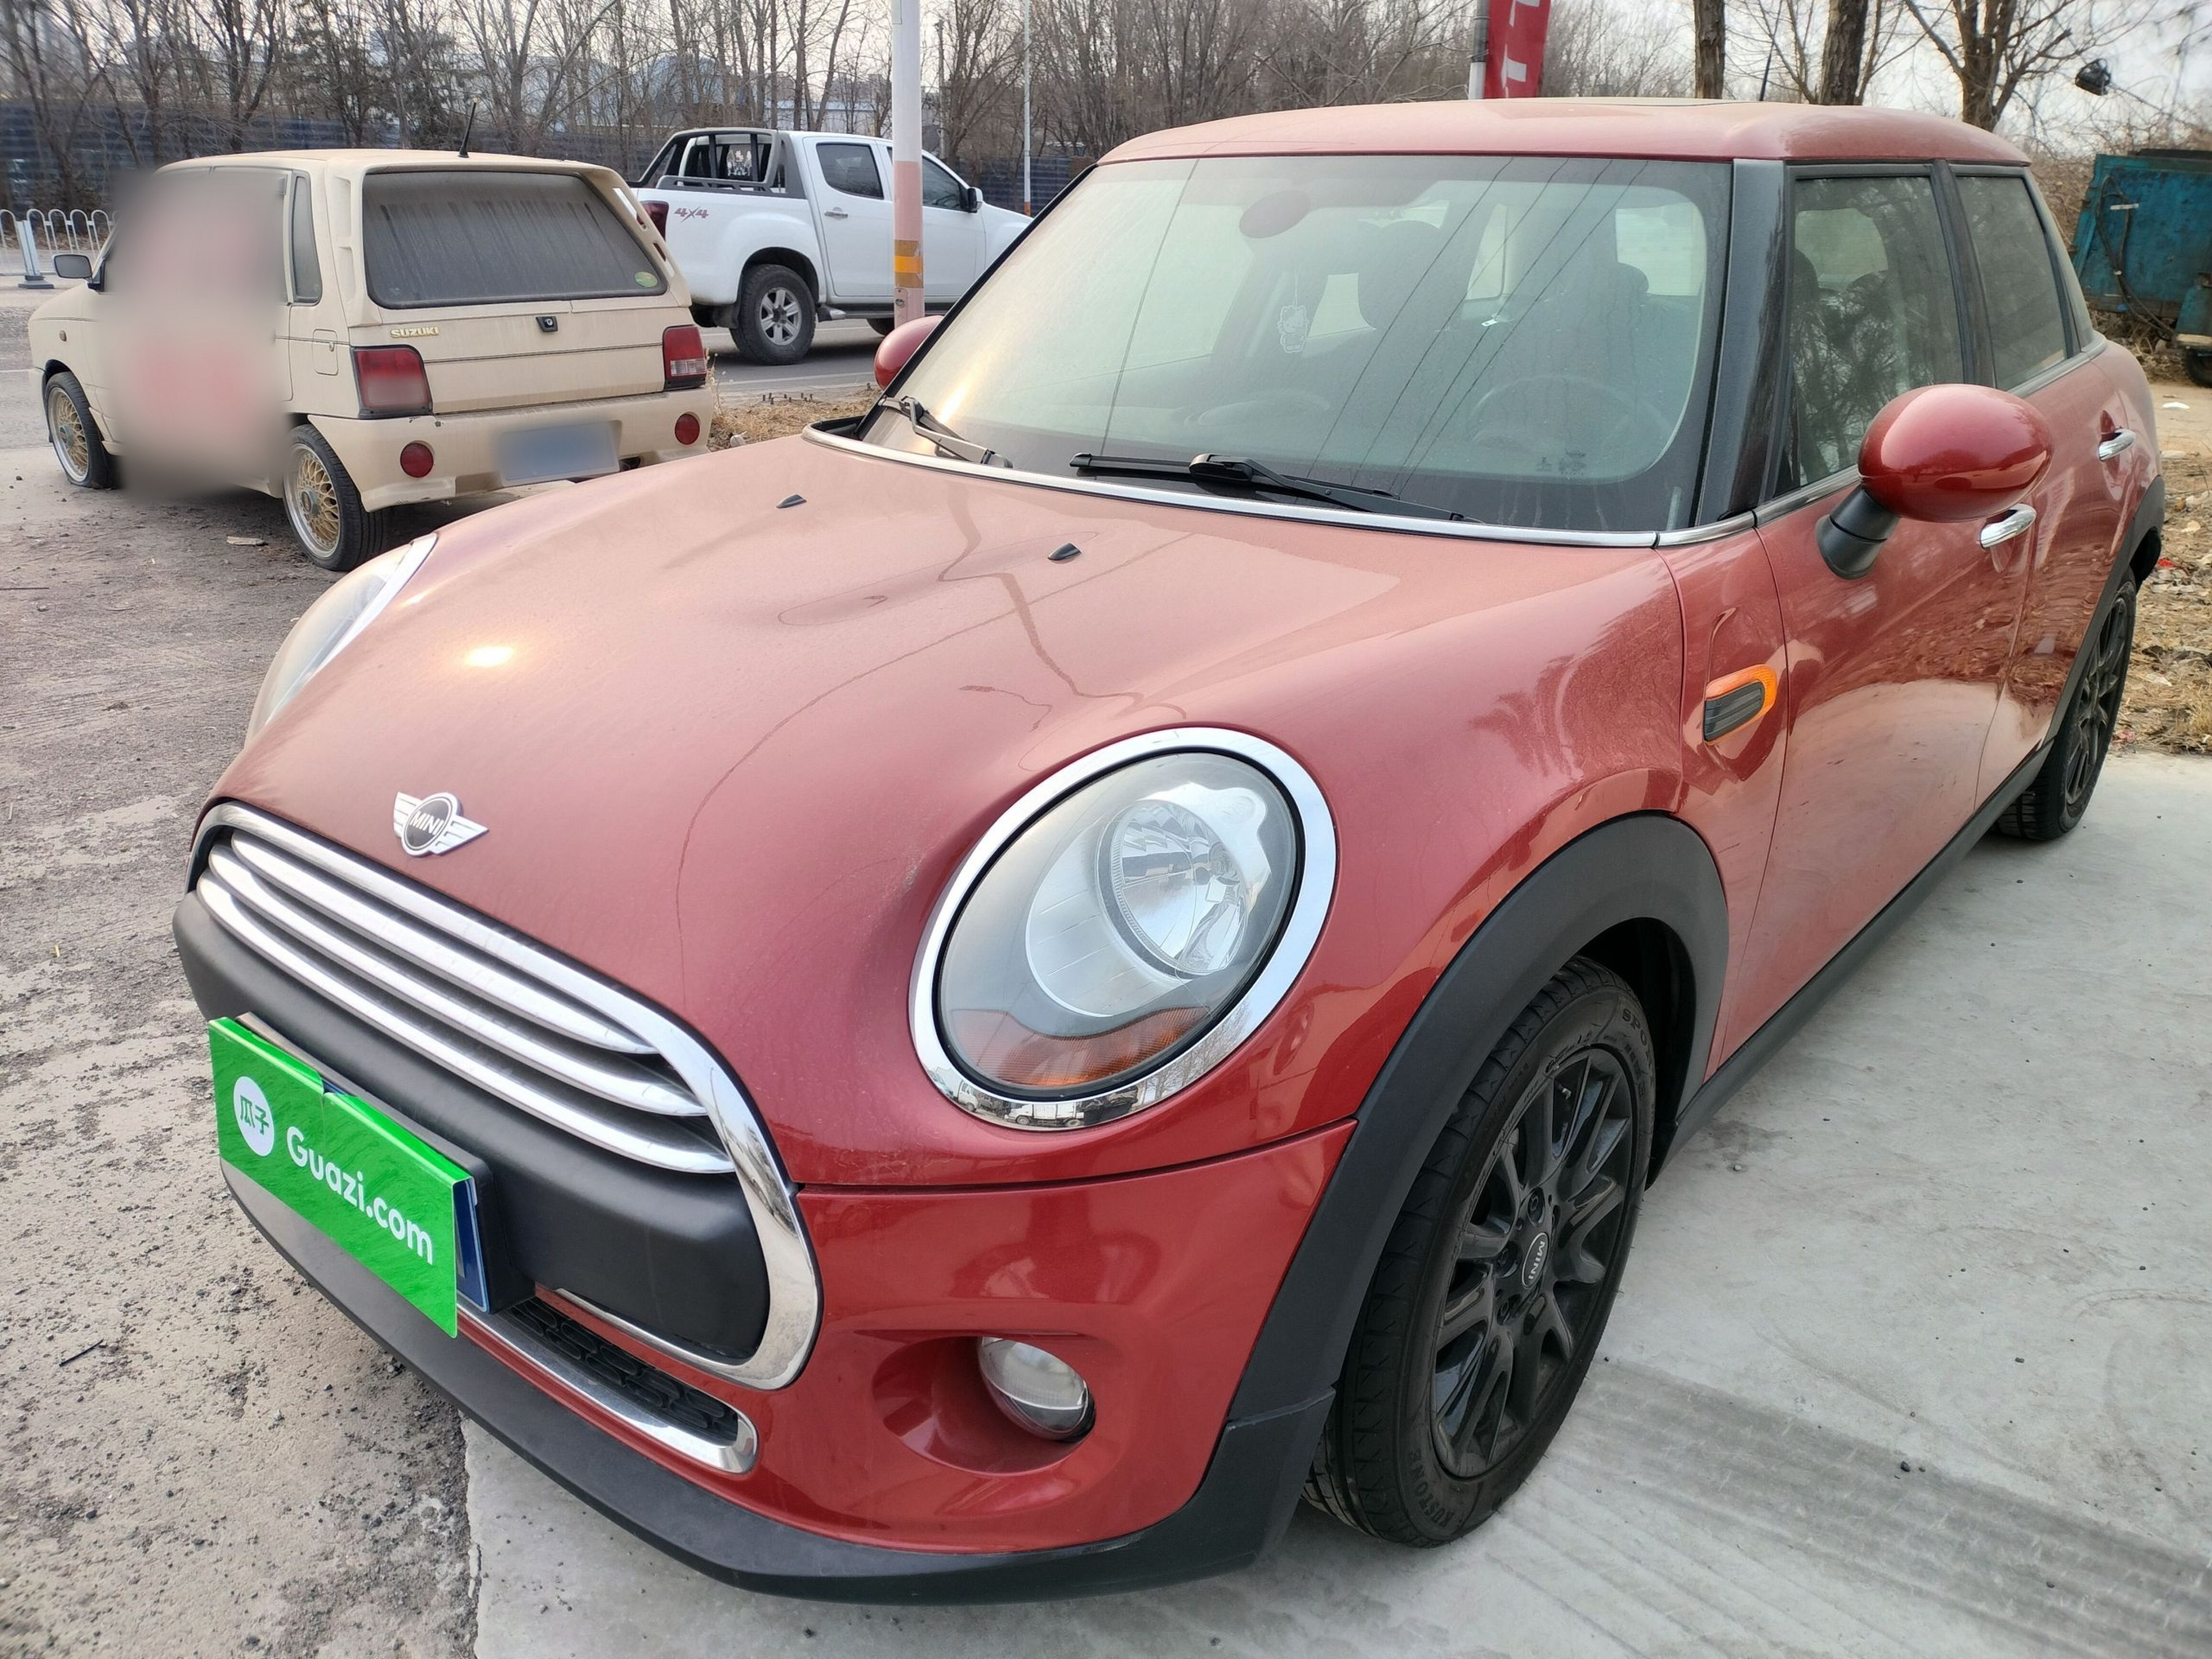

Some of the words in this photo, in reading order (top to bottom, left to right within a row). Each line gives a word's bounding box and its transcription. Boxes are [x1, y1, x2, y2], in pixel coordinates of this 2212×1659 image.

[391, 327, 439, 338] SUZUKI
[410, 810, 444, 835] MINI
[240, 1096, 270, 1135] 瓜子
[287, 1126, 433, 1266] Guazi.com
[1528, 1241, 1546, 1279] MINI
